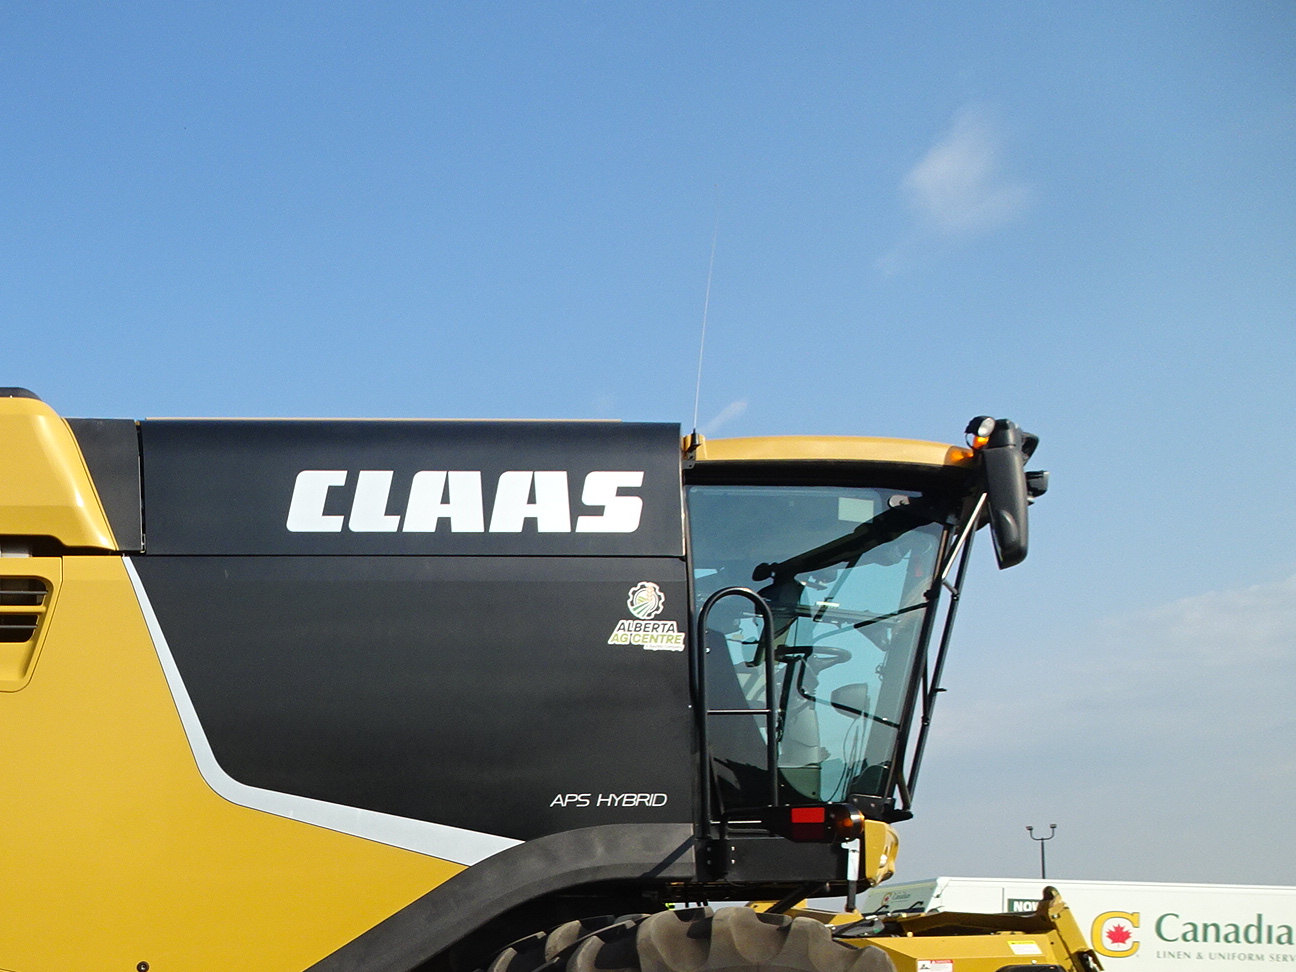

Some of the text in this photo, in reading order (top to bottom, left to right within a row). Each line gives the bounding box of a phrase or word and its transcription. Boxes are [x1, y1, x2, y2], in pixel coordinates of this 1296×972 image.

[286, 470, 645, 533] CLAAS
[616, 622, 675, 633] ALBERTA
[610, 633, 683, 644] AG CENTRE
[549, 793, 668, 807] APS HYBRID
[1155, 913, 1295, 946] Canadia
[1156, 950, 1192, 960] LINEN
[1196, 952, 1204, 960] &
[1208, 952, 1265, 962] UNIFORM
